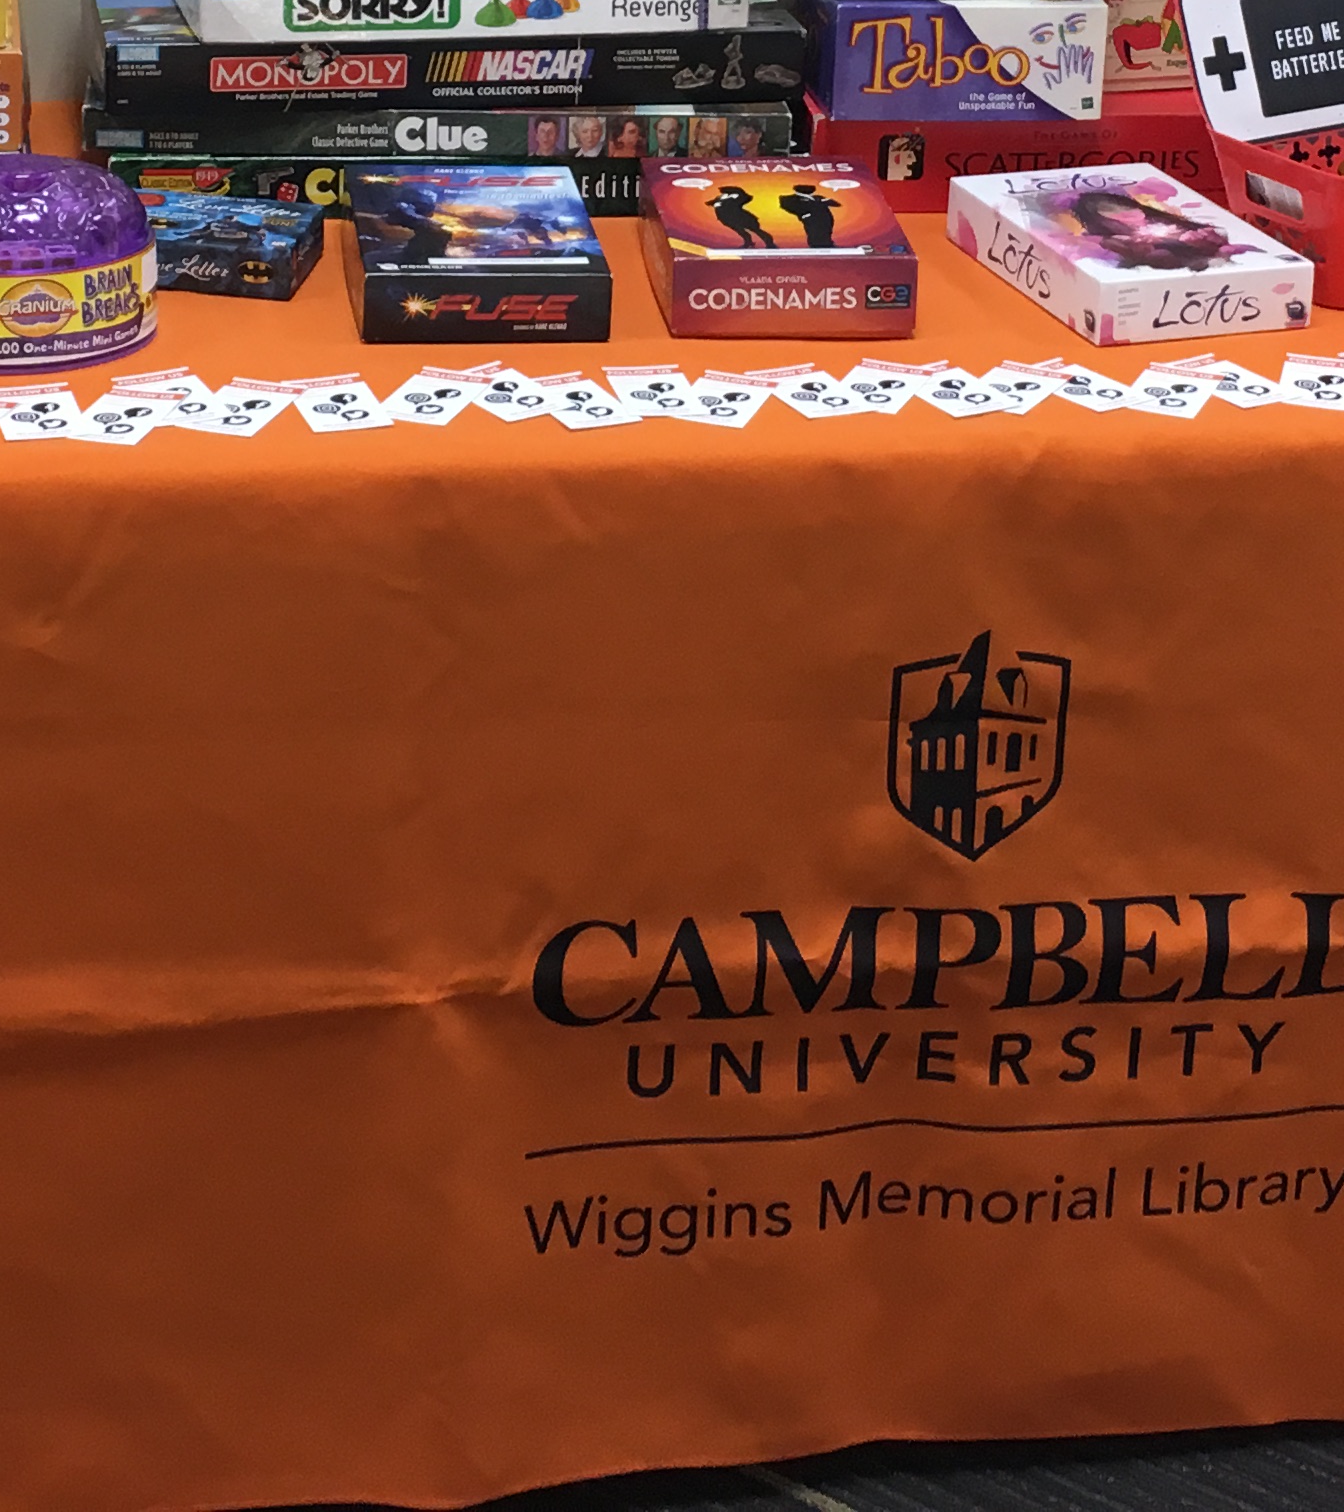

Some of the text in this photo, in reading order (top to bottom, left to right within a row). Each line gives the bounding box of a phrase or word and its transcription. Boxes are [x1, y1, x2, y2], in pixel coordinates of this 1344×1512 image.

[1274, 20, 1342, 51] FEED ME
[477, 49, 586, 82] NASCAR
[852, 16, 1030, 95] Taboo
[215, 59, 404, 88] MONOPOLY
[431, 85, 583, 97] OFFICIAL COLLECTOR'S EDITION
[394, 116, 489, 151] Clue
[660, 162, 855, 174] CODENAMES
[83, 265, 135, 298] BRAIN
[428, 293, 578, 323] FUSE
[688, 287, 858, 311] CODENAMES
[23, 339, 90, 354] One-Minute
[92, 333, 113, 347] Mini
[626, 1022, 1287, 1098] UNIVERSITY
[524, 1187, 794, 1258] Wiggins
[818, 1165, 1117, 1229] Memorial
